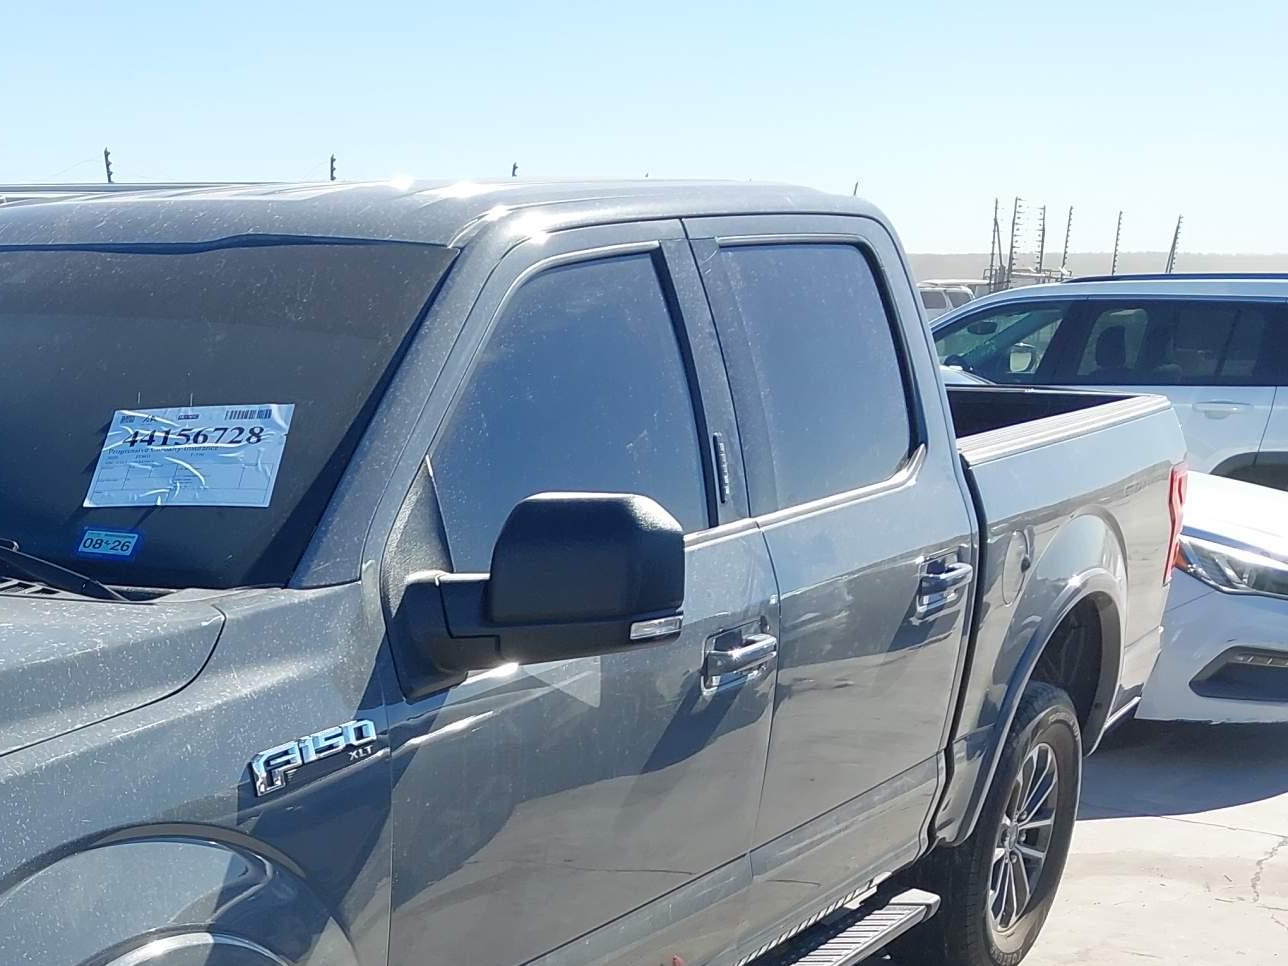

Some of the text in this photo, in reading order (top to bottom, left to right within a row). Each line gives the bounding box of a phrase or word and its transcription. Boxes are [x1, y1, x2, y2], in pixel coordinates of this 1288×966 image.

[123, 426, 265, 448] 44156728
[83, 537, 132, 552] 08 26
[348, 745, 374, 760] XLT
